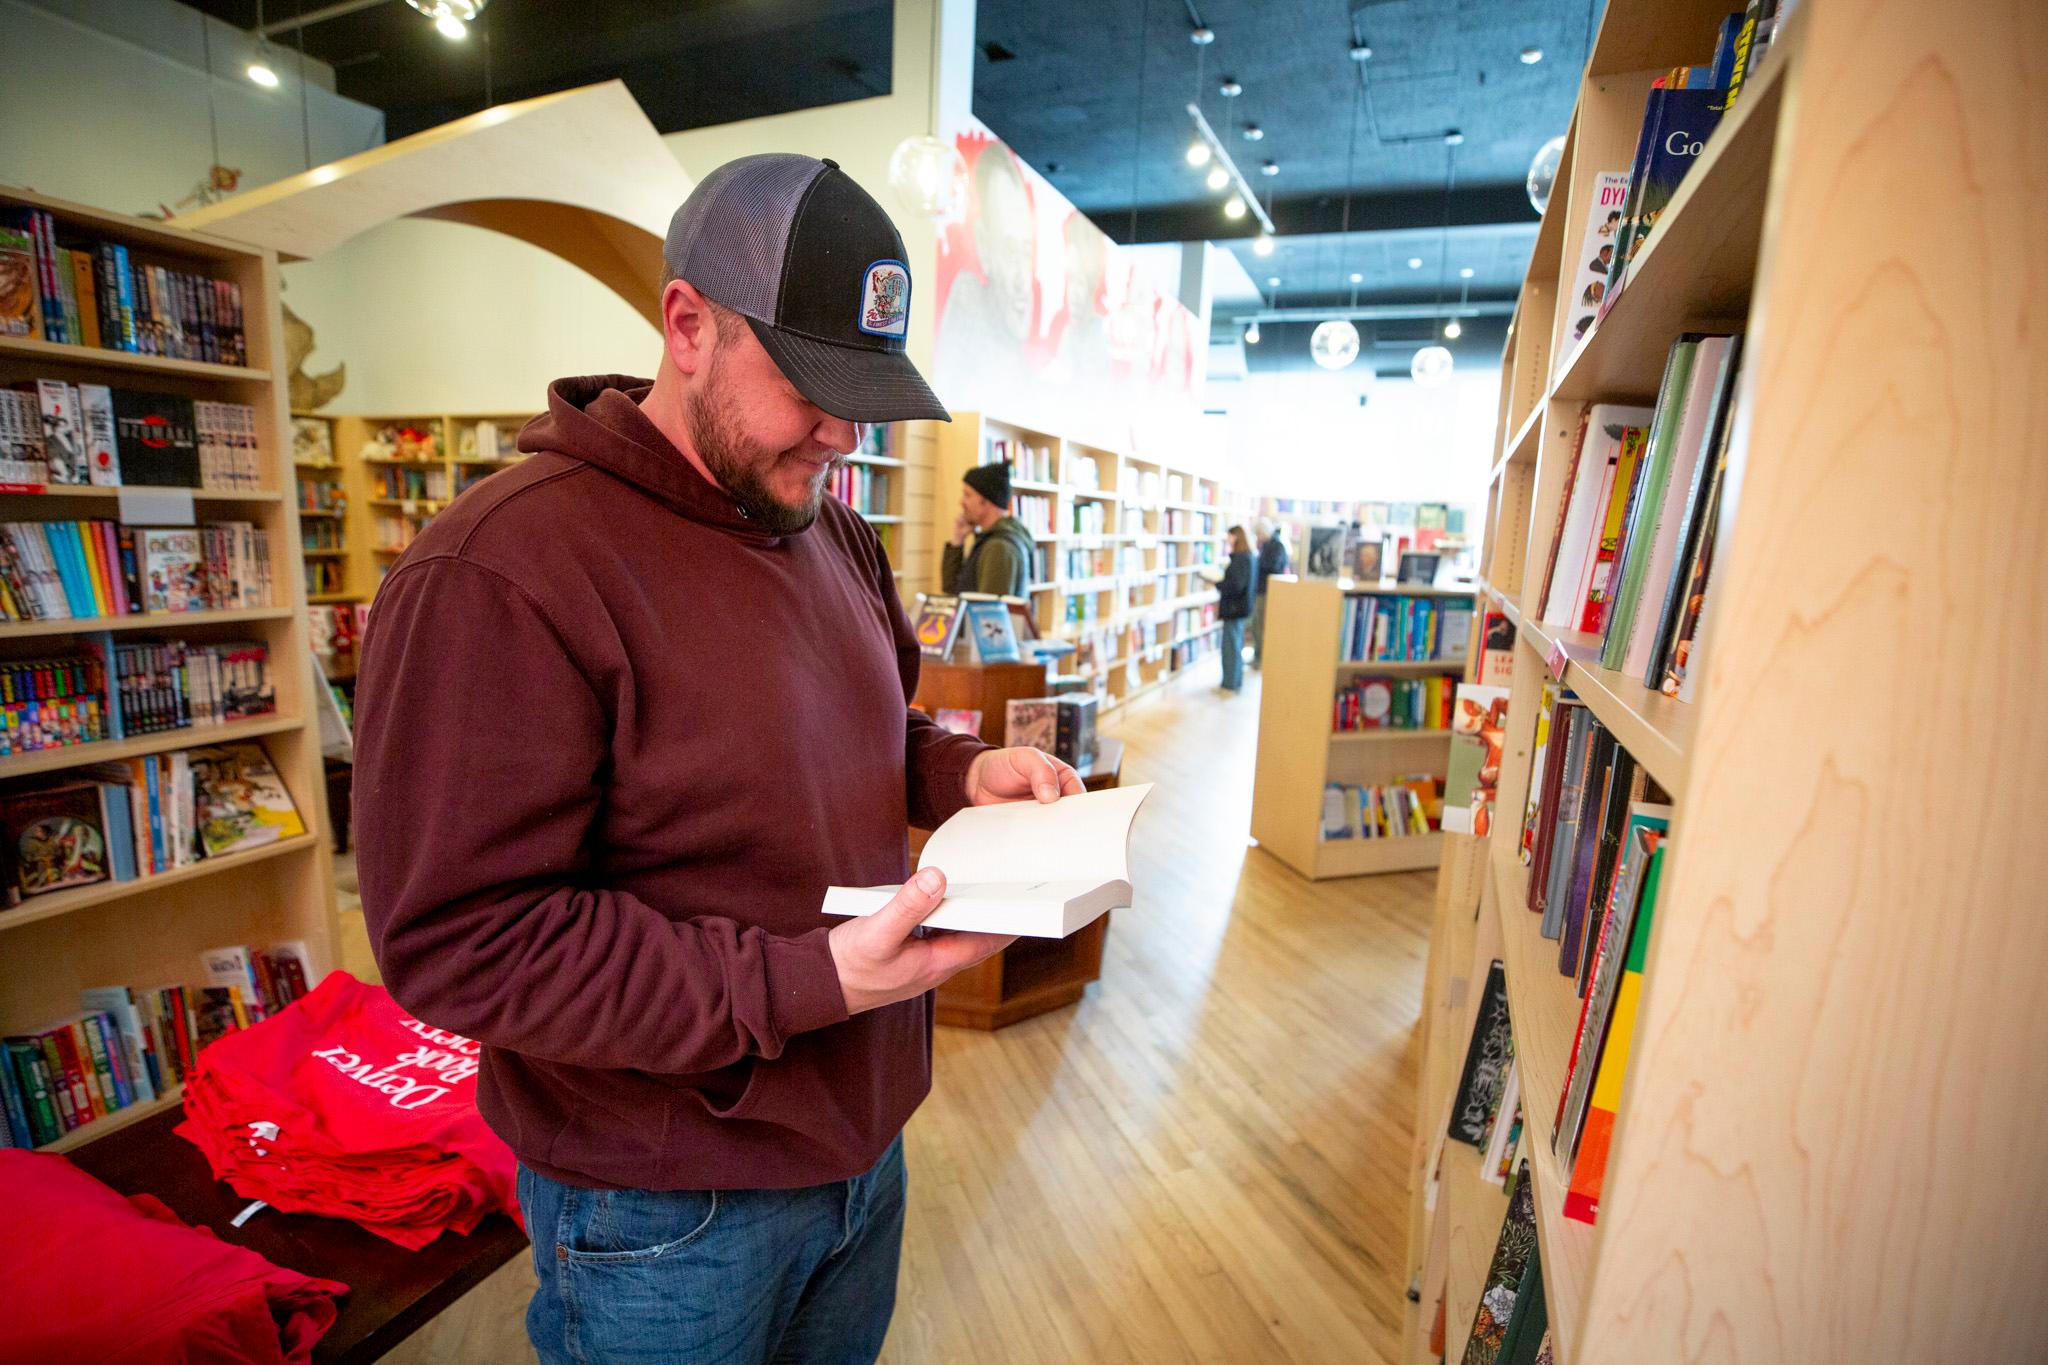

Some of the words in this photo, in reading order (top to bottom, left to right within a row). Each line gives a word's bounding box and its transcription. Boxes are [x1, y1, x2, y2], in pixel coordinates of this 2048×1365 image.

[1730, 18, 1755, 88] STEVE
[1665, 131, 1704, 156] Go
[312, 1045, 452, 1109] Denver
[382, 1045, 479, 1084] Book
